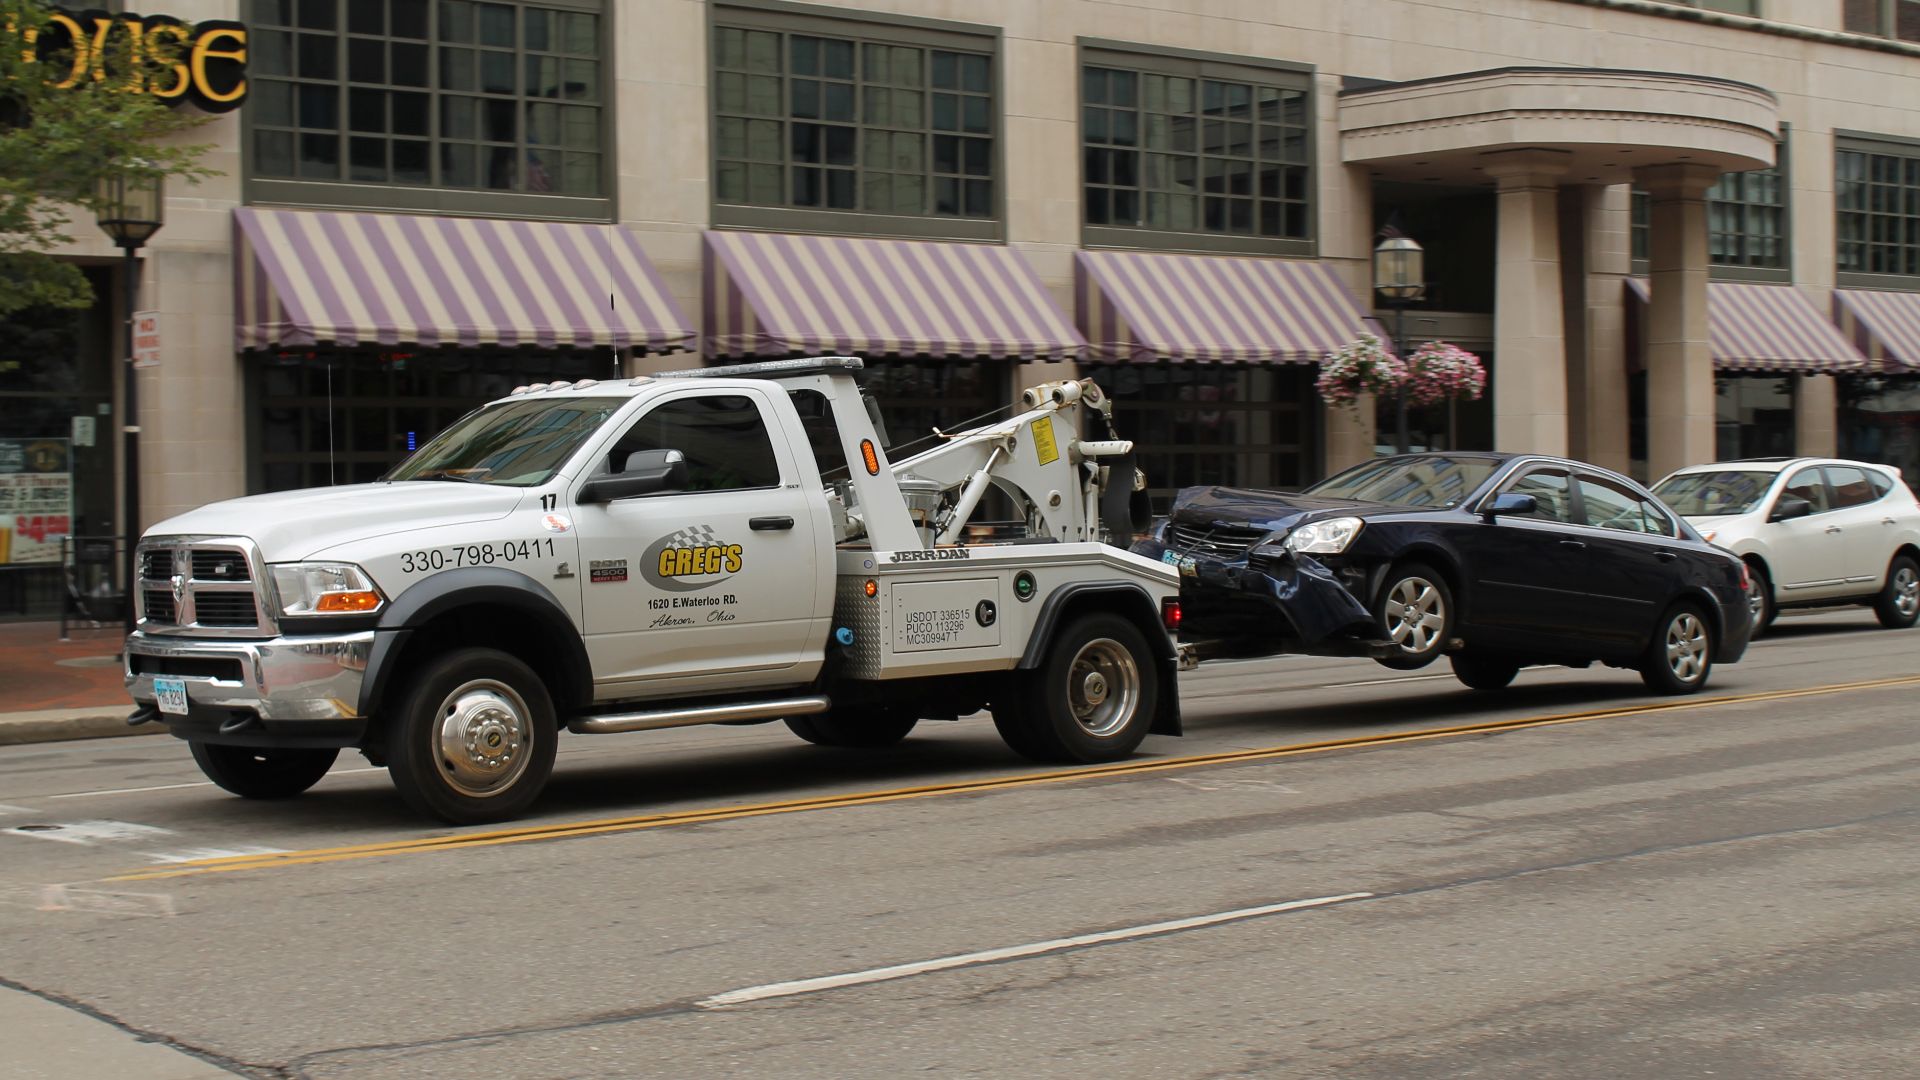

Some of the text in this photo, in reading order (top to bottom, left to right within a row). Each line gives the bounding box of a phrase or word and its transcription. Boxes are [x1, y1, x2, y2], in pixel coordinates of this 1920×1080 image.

[540, 493, 557, 512] 17
[401, 537, 555, 573] 330-798-0411
[658, 543, 743, 577] GREG'S
[593, 568, 625, 576] 4500
[647, 594, 738, 610] 1620 E.Waterloo RD.
[706, 609, 736, 623] Ohio
[906, 609, 970, 623] USDOT 336515
[906, 620, 965, 634] PUCO 113296
[906, 631, 959, 645] MC309947 T
